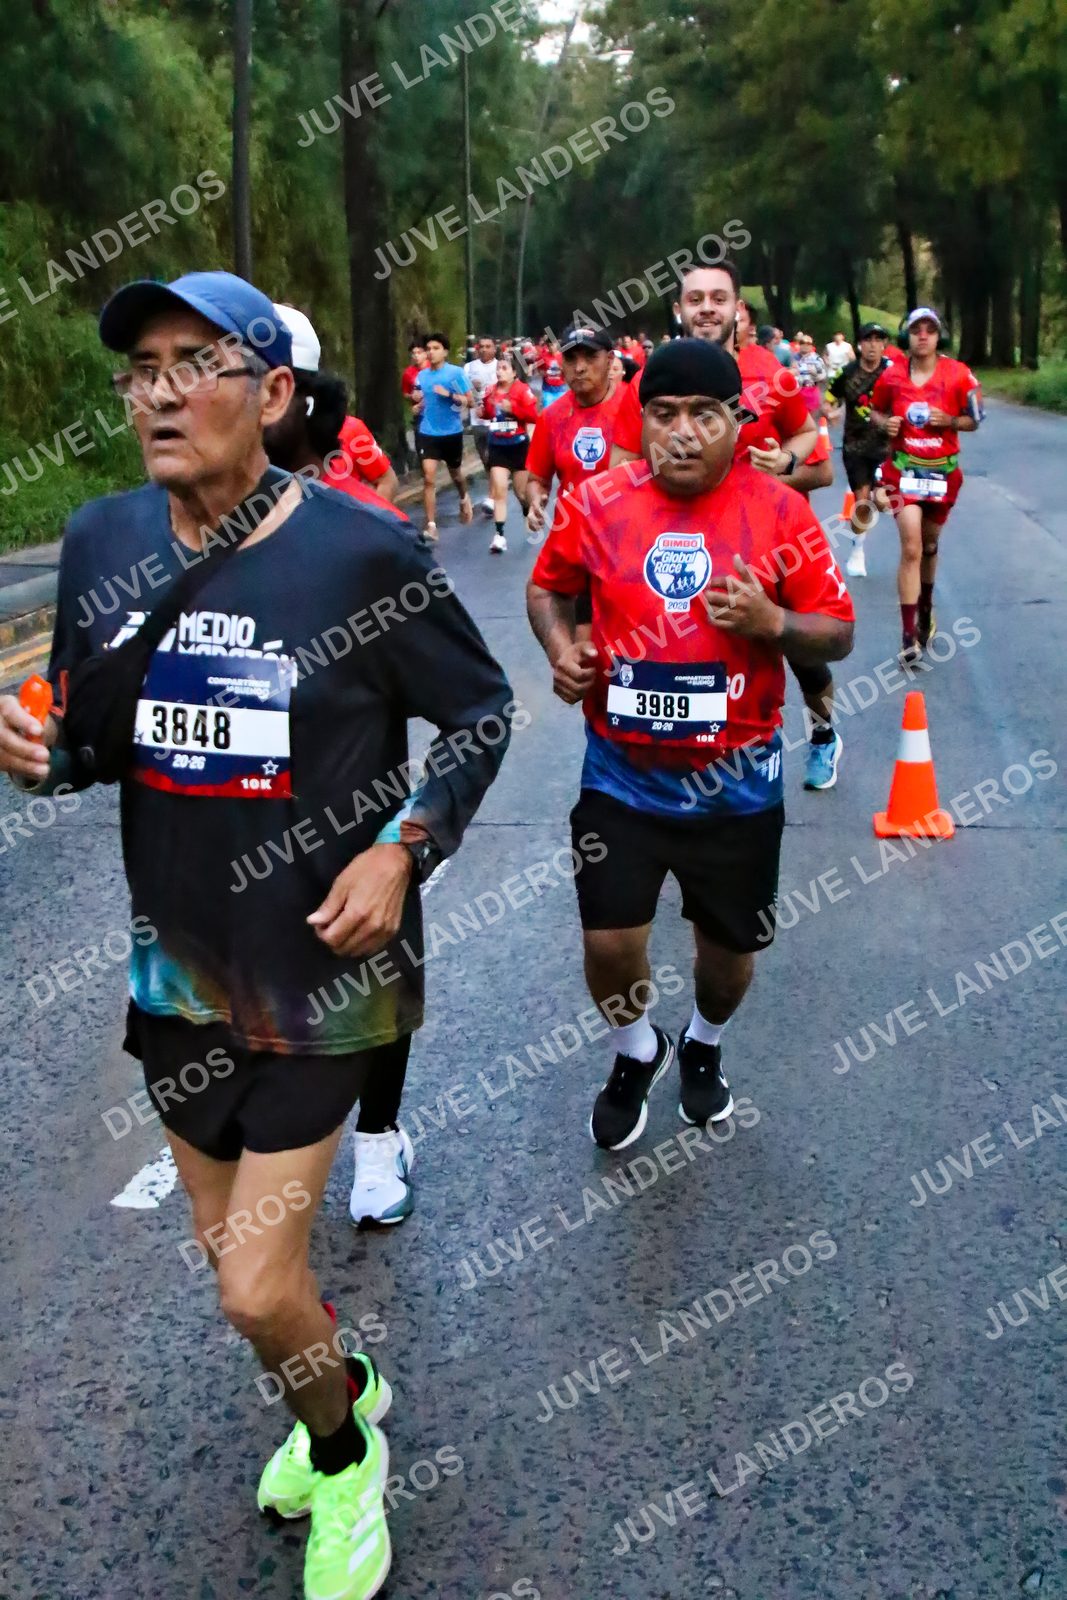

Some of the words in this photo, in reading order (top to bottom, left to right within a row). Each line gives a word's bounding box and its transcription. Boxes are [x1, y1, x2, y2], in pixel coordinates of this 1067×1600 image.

[662, 539, 698, 548] BIMBO
[661, 551, 697, 564] Global
[654, 561, 682, 574] Race
[178, 610, 256, 648] MEDIO
[636, 692, 690, 718] 3989
[152, 705, 231, 750] 3848
[695, 734, 715, 743] 10K
[172, 753, 206, 770] 20-26
[241, 778, 272, 790] 10K
